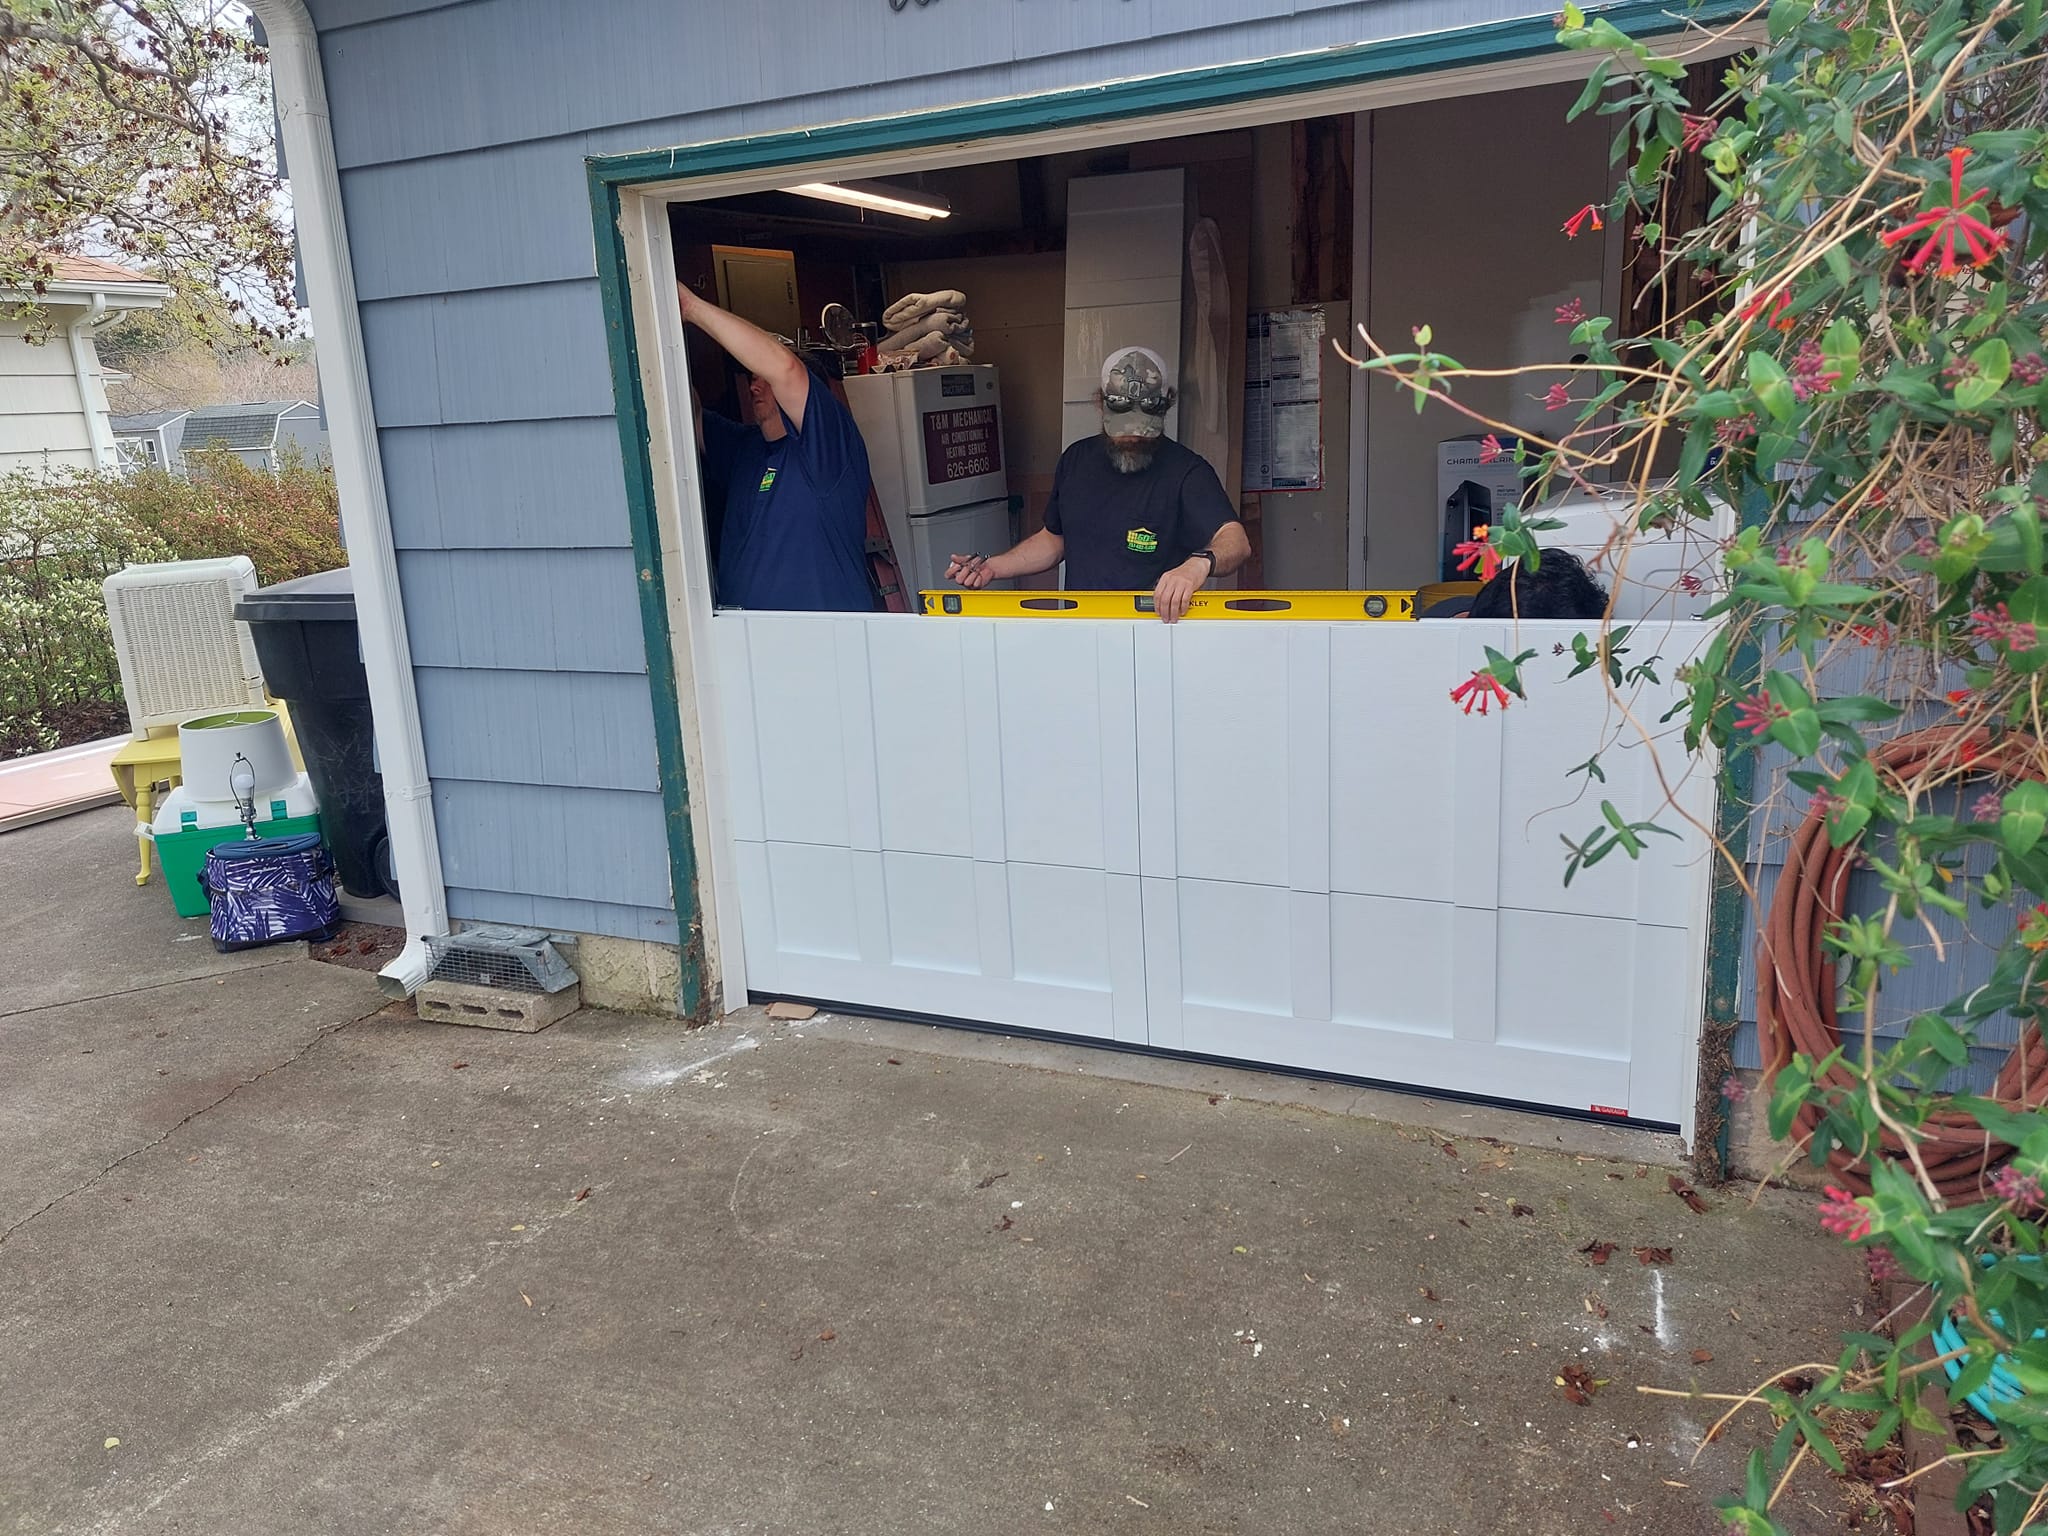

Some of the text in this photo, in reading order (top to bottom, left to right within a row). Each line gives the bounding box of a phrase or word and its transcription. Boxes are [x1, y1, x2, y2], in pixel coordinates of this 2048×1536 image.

[930, 409, 993, 430] T&M MECHANICAL
[968, 442, 987, 456] SERVICE
[946, 457, 990, 478] 626-6608
